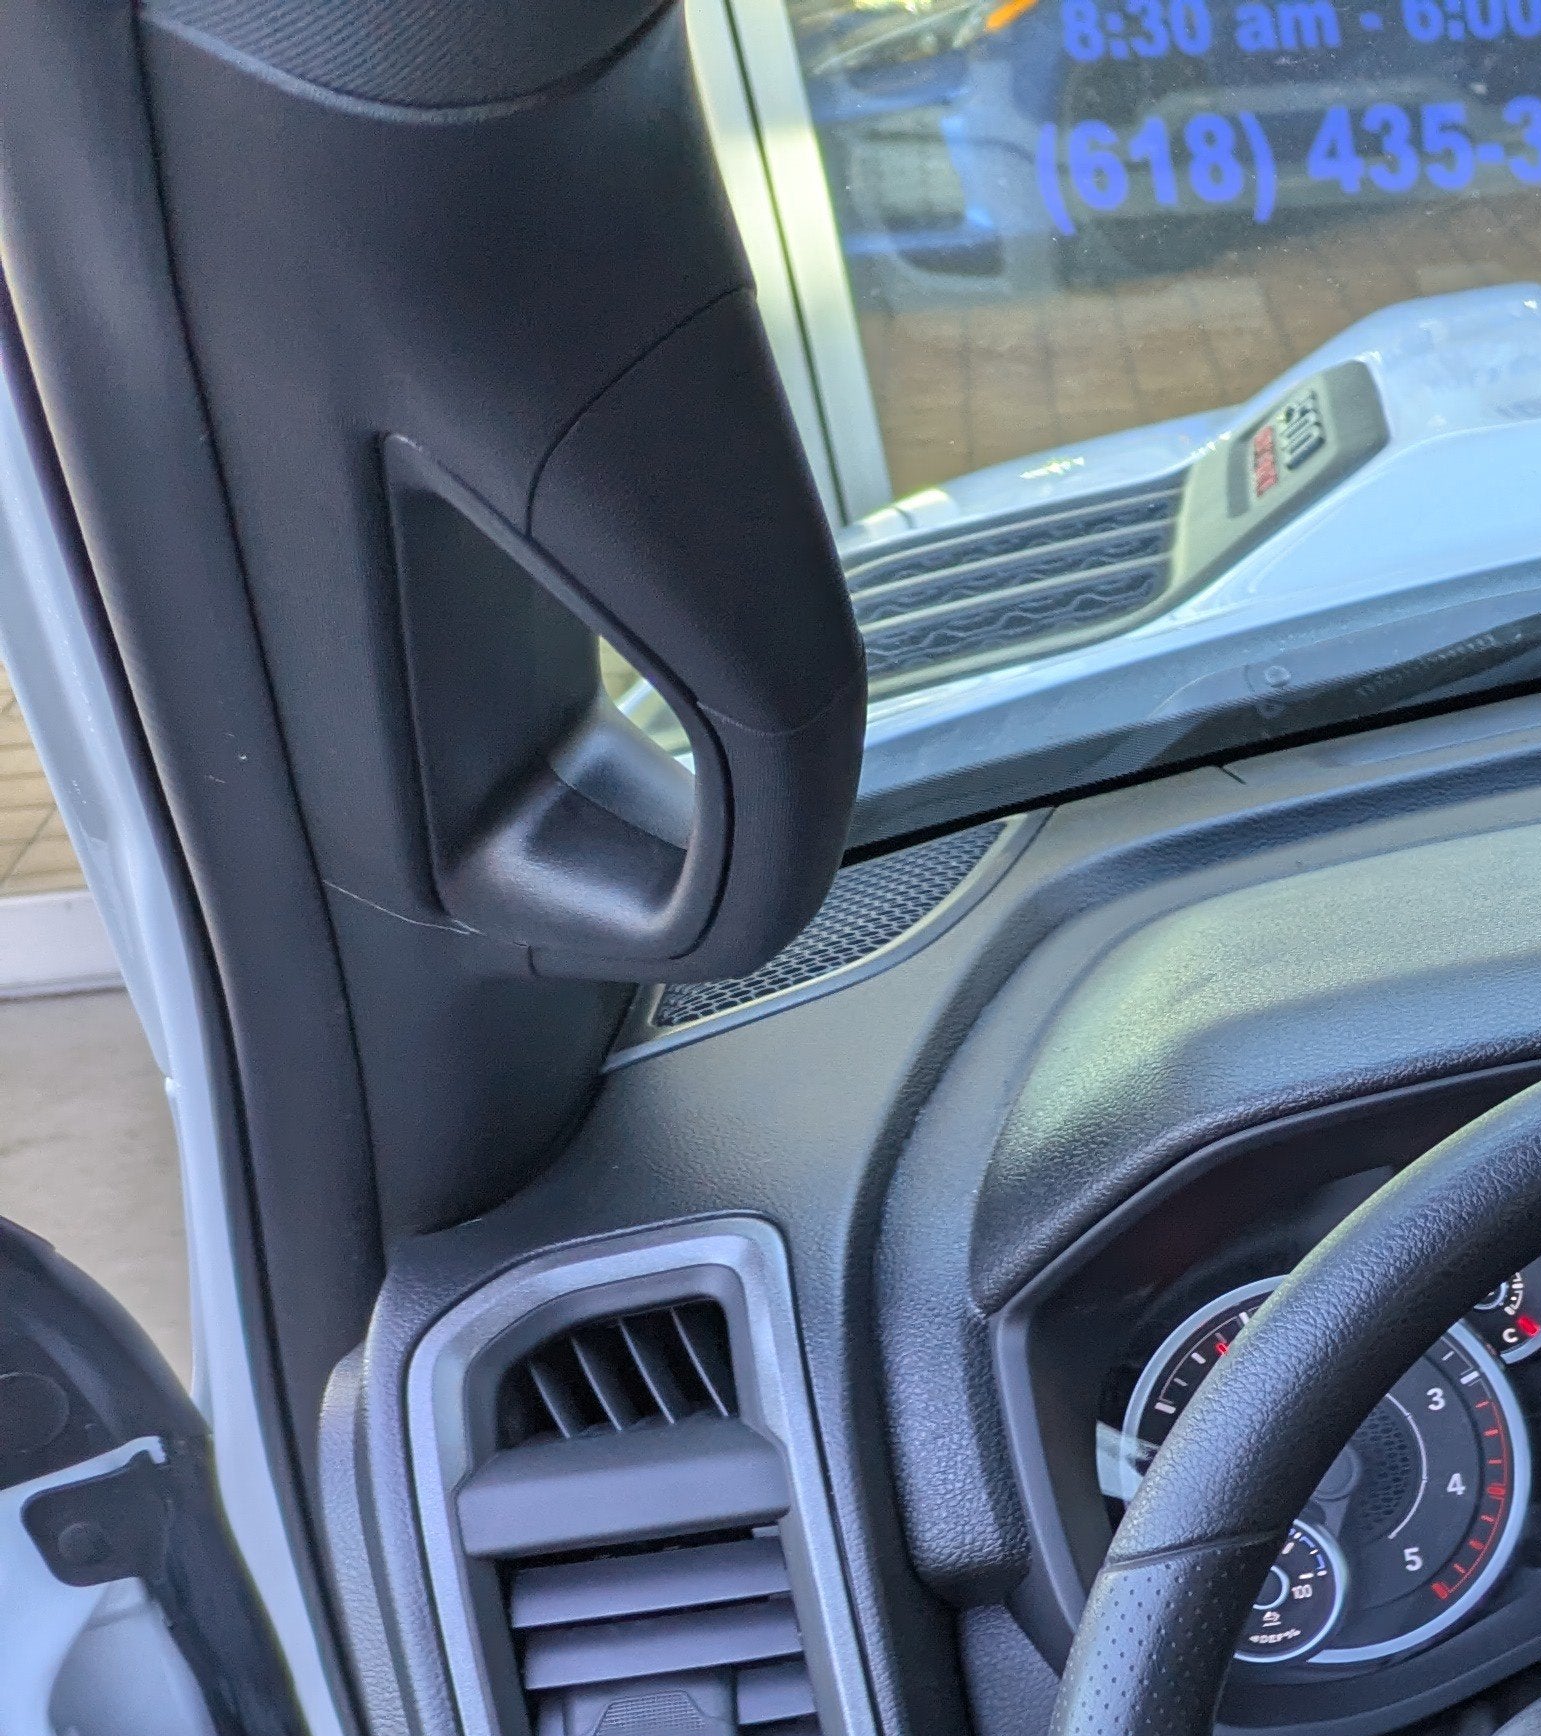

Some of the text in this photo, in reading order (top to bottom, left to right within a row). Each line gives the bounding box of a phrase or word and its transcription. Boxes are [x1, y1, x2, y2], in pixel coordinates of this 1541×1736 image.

[1060, 0, 1212, 62] 8:30
[1236, 2, 1341, 53] am
[1035, 113, 1278, 235] (618)
[1502, 1328, 1518, 1344] C
[1426, 1388, 1446, 1412] 3
[1447, 1472, 1465, 1496] 4
[1403, 1547, 1423, 1571] 5
